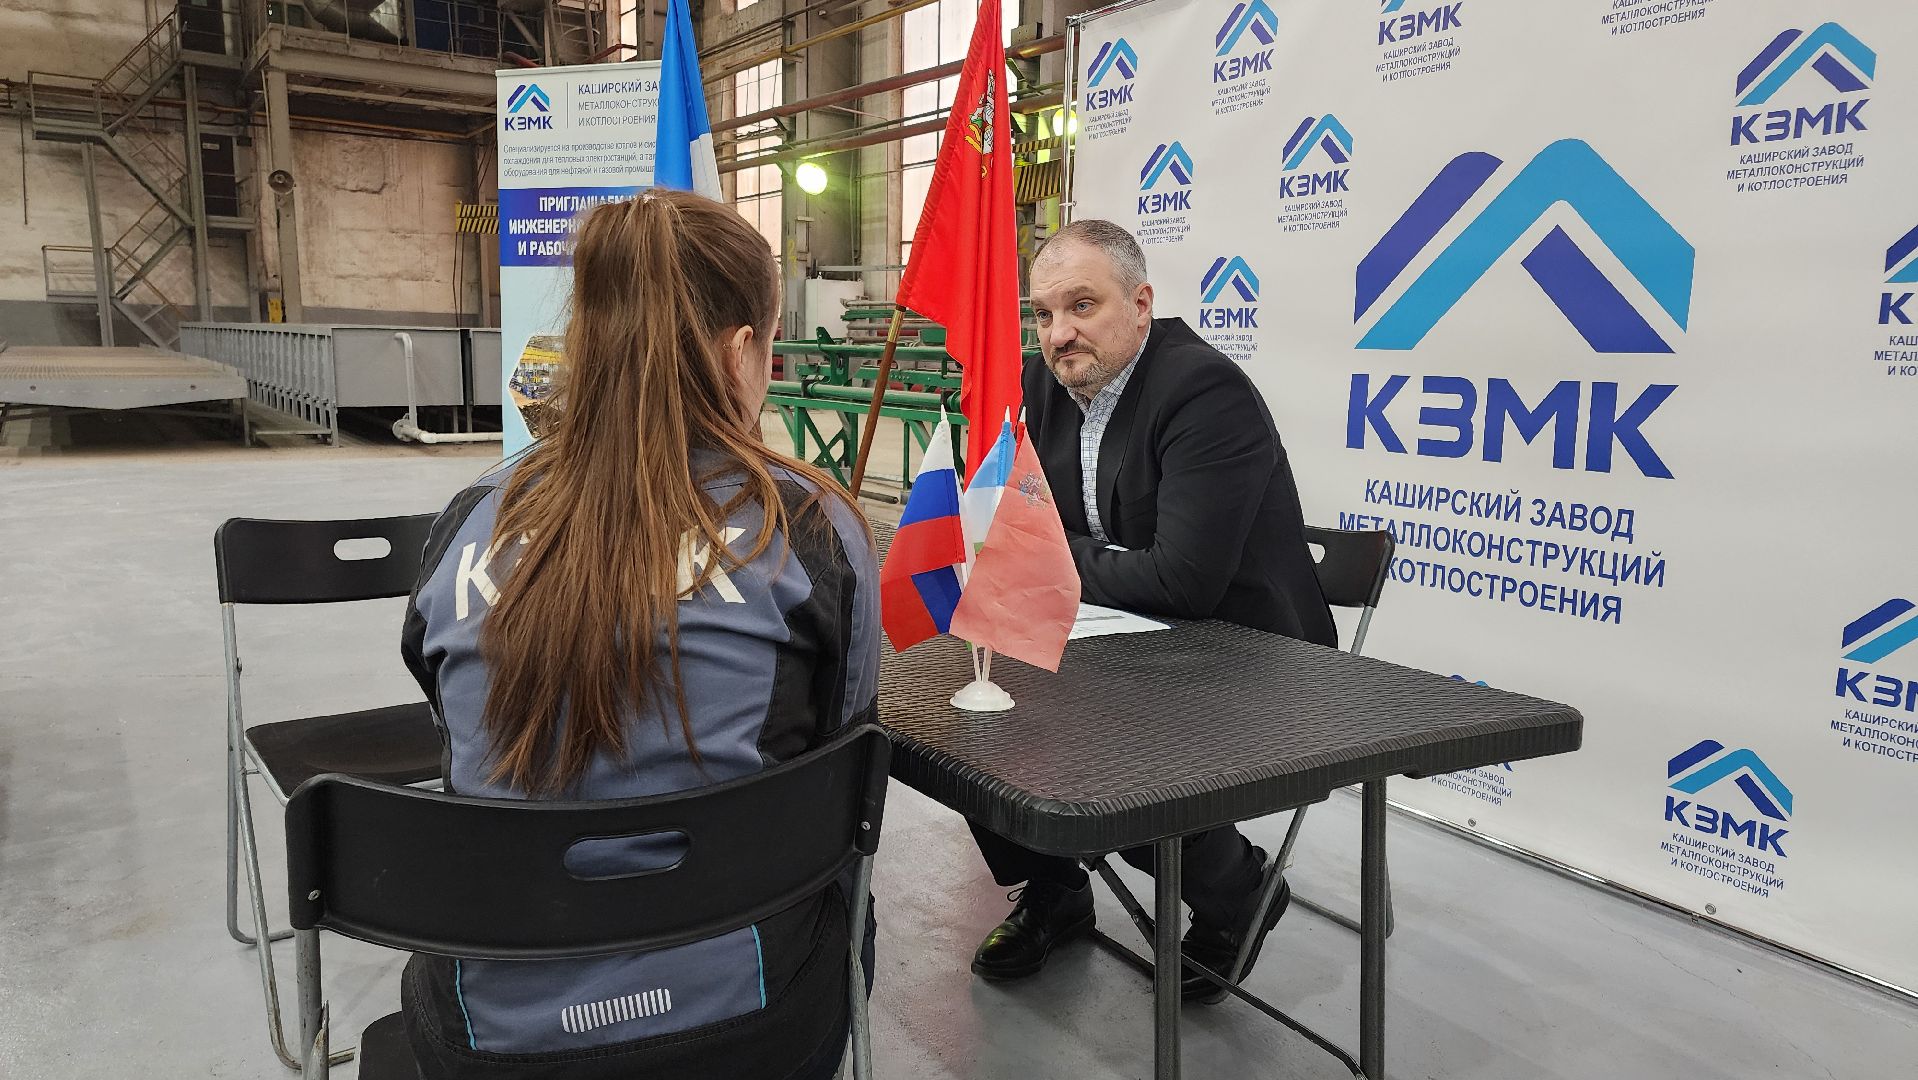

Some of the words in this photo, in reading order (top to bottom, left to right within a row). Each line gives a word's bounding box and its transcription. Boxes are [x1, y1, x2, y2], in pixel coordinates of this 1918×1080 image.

[1378, 1, 1463, 45] КЗМК
[1612, 26, 1618, 35] И
[1620, 8, 1705, 34] КОТЛОСТРОЕНИЯ
[1376, 46, 1461, 72] МЕТАЛЛОКОНСТРУКЦИЙ
[1384, 42, 1427, 60] КАШИРСКИЙ
[1429, 37, 1454, 51] ЗАВОД
[1214, 49, 1274, 83] КЗМК
[1390, 61, 1451, 81] КОТЛОСТРОЕНИЯ
[578, 79, 642, 95] КАШИРСКИЙ
[1086, 83, 1134, 111] КЗМК
[578, 98, 658, 111] МЕТАЛЛОКОНСТРУК
[505, 116, 553, 131] КЗМК
[585, 115, 656, 126] КОТЛОСТРОЕНИЯ
[1731, 99, 1870, 146] КЗМК
[1740, 147, 1809, 165] КАШИРСКИЙ
[1812, 143, 1853, 157] ЗАВОД
[1727, 155, 1864, 180] МЕТАЛЛОКОНСТРУКЦИЙ
[1280, 169, 1350, 199] КЗМК
[1748, 174, 1848, 192] КОТЛОСТРОЕНИЯ
[1138, 190, 1192, 214] КЗМК
[518, 241, 527, 255] И
[1200, 308, 1258, 328] КЗМК
[1346, 373, 1679, 479] КЗМК
[1364, 479, 1521, 522] КАШИРСКИЙ
[1530, 498, 1635, 544] ЗАВОД
[1340, 512, 1666, 588] МЕТАЛЛОКОНСТРУКЦИЙ
[1843, 737, 1851, 747] И
[1478, 769, 1505, 786] ЗАВОД
[1438, 778, 1502, 807] КОТЛОСТРОЕНИЯ
[1665, 795, 1789, 858] КЗМК
[1661, 842, 1784, 890] МЕТАЛЛОКОНСТРУКЦИЙ
[1673, 833, 1736, 860] КАШИРСКИЙ
[1738, 853, 1775, 874] ЗАВОД
[1681, 860, 1769, 898] КОТЛОСТРОЕНИЯ
